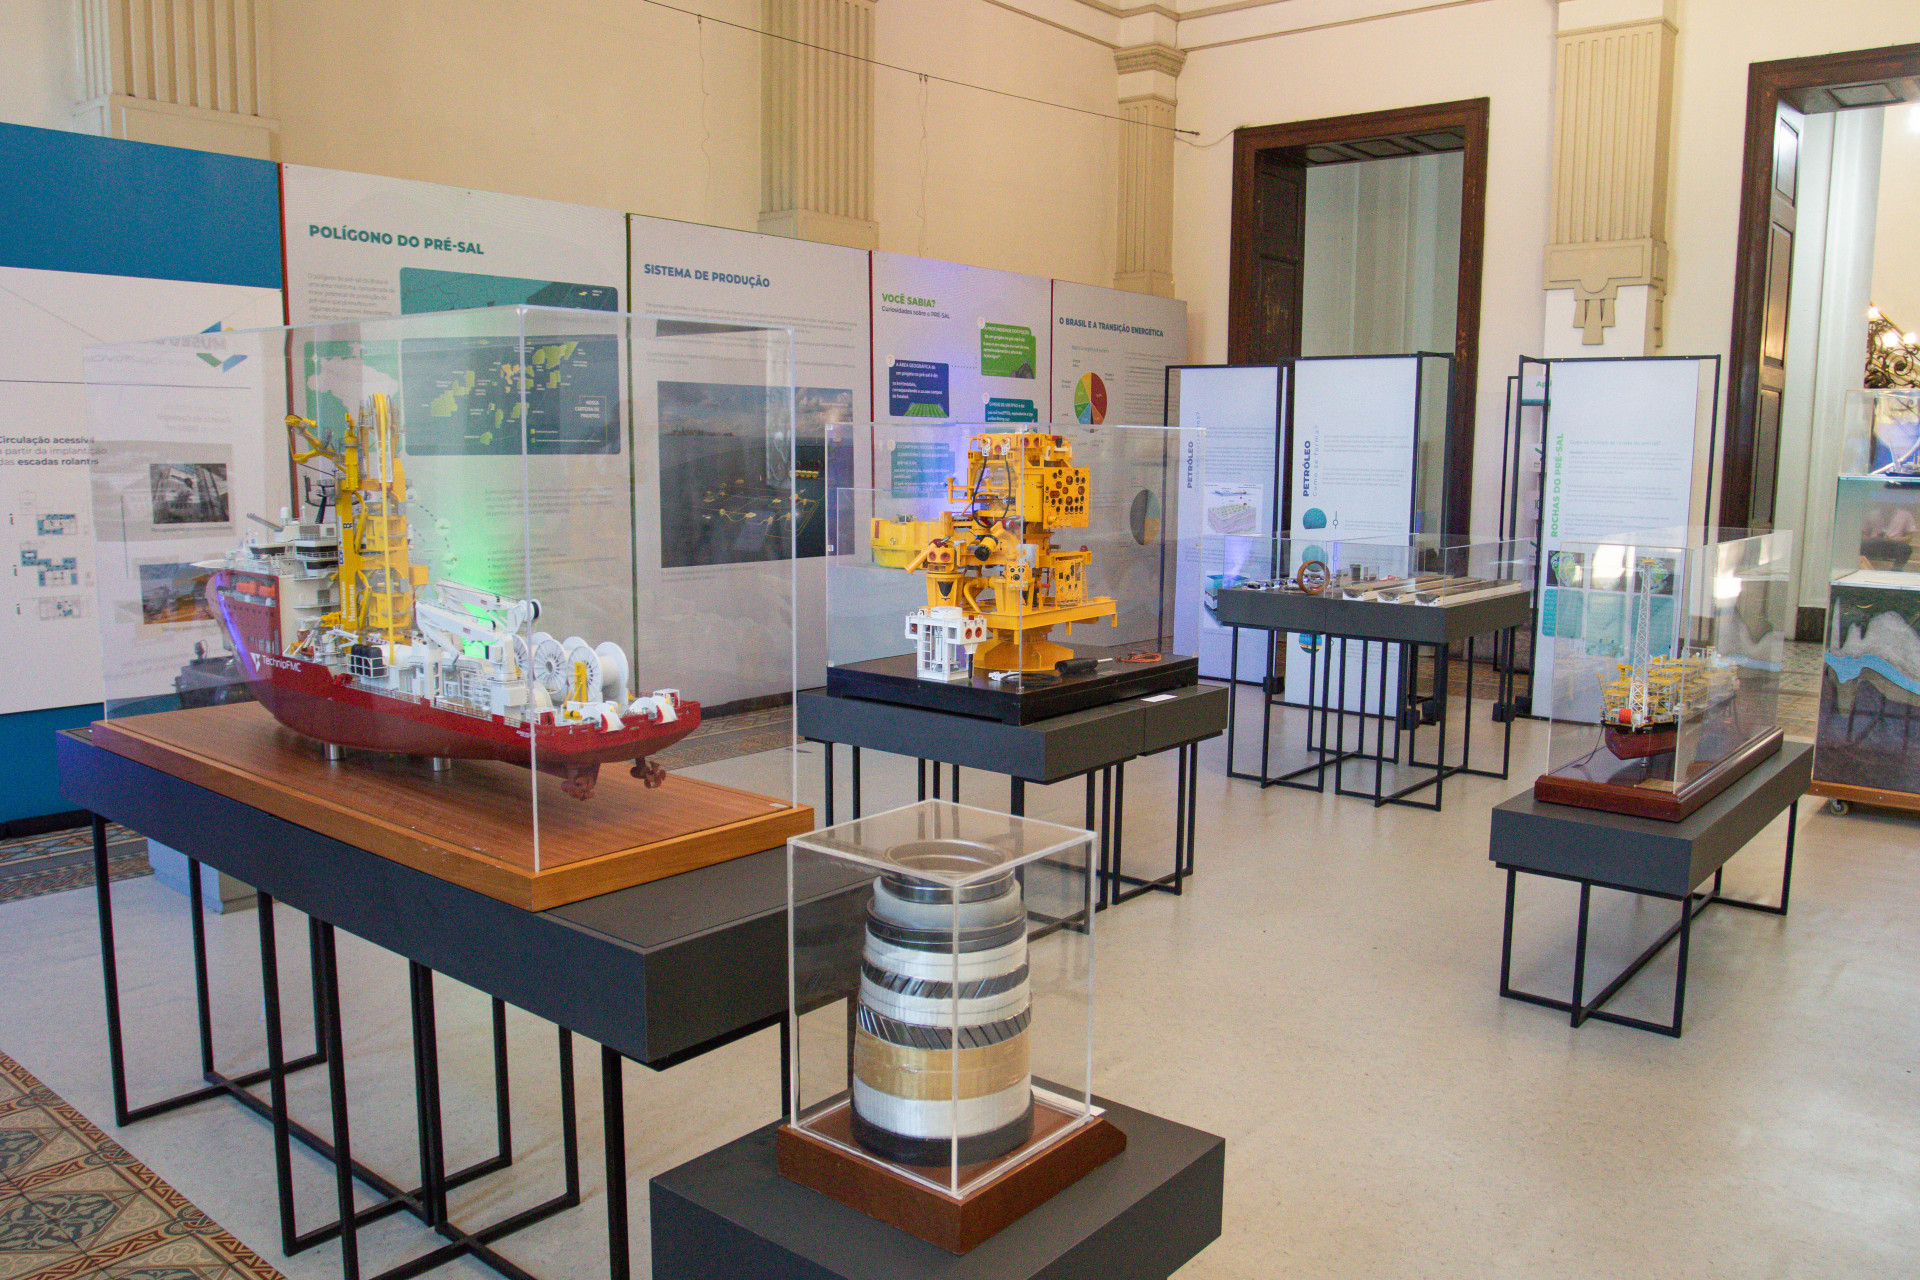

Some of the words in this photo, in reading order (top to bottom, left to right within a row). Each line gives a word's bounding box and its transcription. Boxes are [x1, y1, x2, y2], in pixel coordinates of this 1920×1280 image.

[309, 224, 393, 245] POLÍGONO
[397, 234, 420, 248] DO
[424, 236, 484, 255] PRÉ-SAL
[644, 263, 692, 279] SISTEMA
[694, 269, 709, 281] DE
[711, 271, 771, 289] PRODUÇÃO
[881, 292, 905, 305] VOCÊ
[907, 295, 936, 308] SABIA?
[881, 305, 913, 315] Curiosidades
[913, 309, 926, 317] sobre
[1059, 316, 1065, 325] O
[1065, 317, 1087, 328] BRASIL
[1087, 320, 1092, 328] E
[1092, 321, 1098, 329] A
[1098, 322, 1131, 334] TRANSIÇÃO
[1131, 326, 1164, 338] ENERGÉTICA
[34, 446, 47, 455] da
[53, 435, 95, 445] acessívl
[17, 458, 59, 466] escadas
[1186, 441, 1194, 489] PETRÓLEO
[1553, 433, 1564, 476] PRÉ-SAL
[1302, 440, 1311, 497] PETRÓLEO
[1553, 478, 1561, 494] DO
[1550, 495, 1561, 538] ROCHAS
[348, 584, 356, 622] Huisman
[261, 654, 302, 673] TechnipFMC
